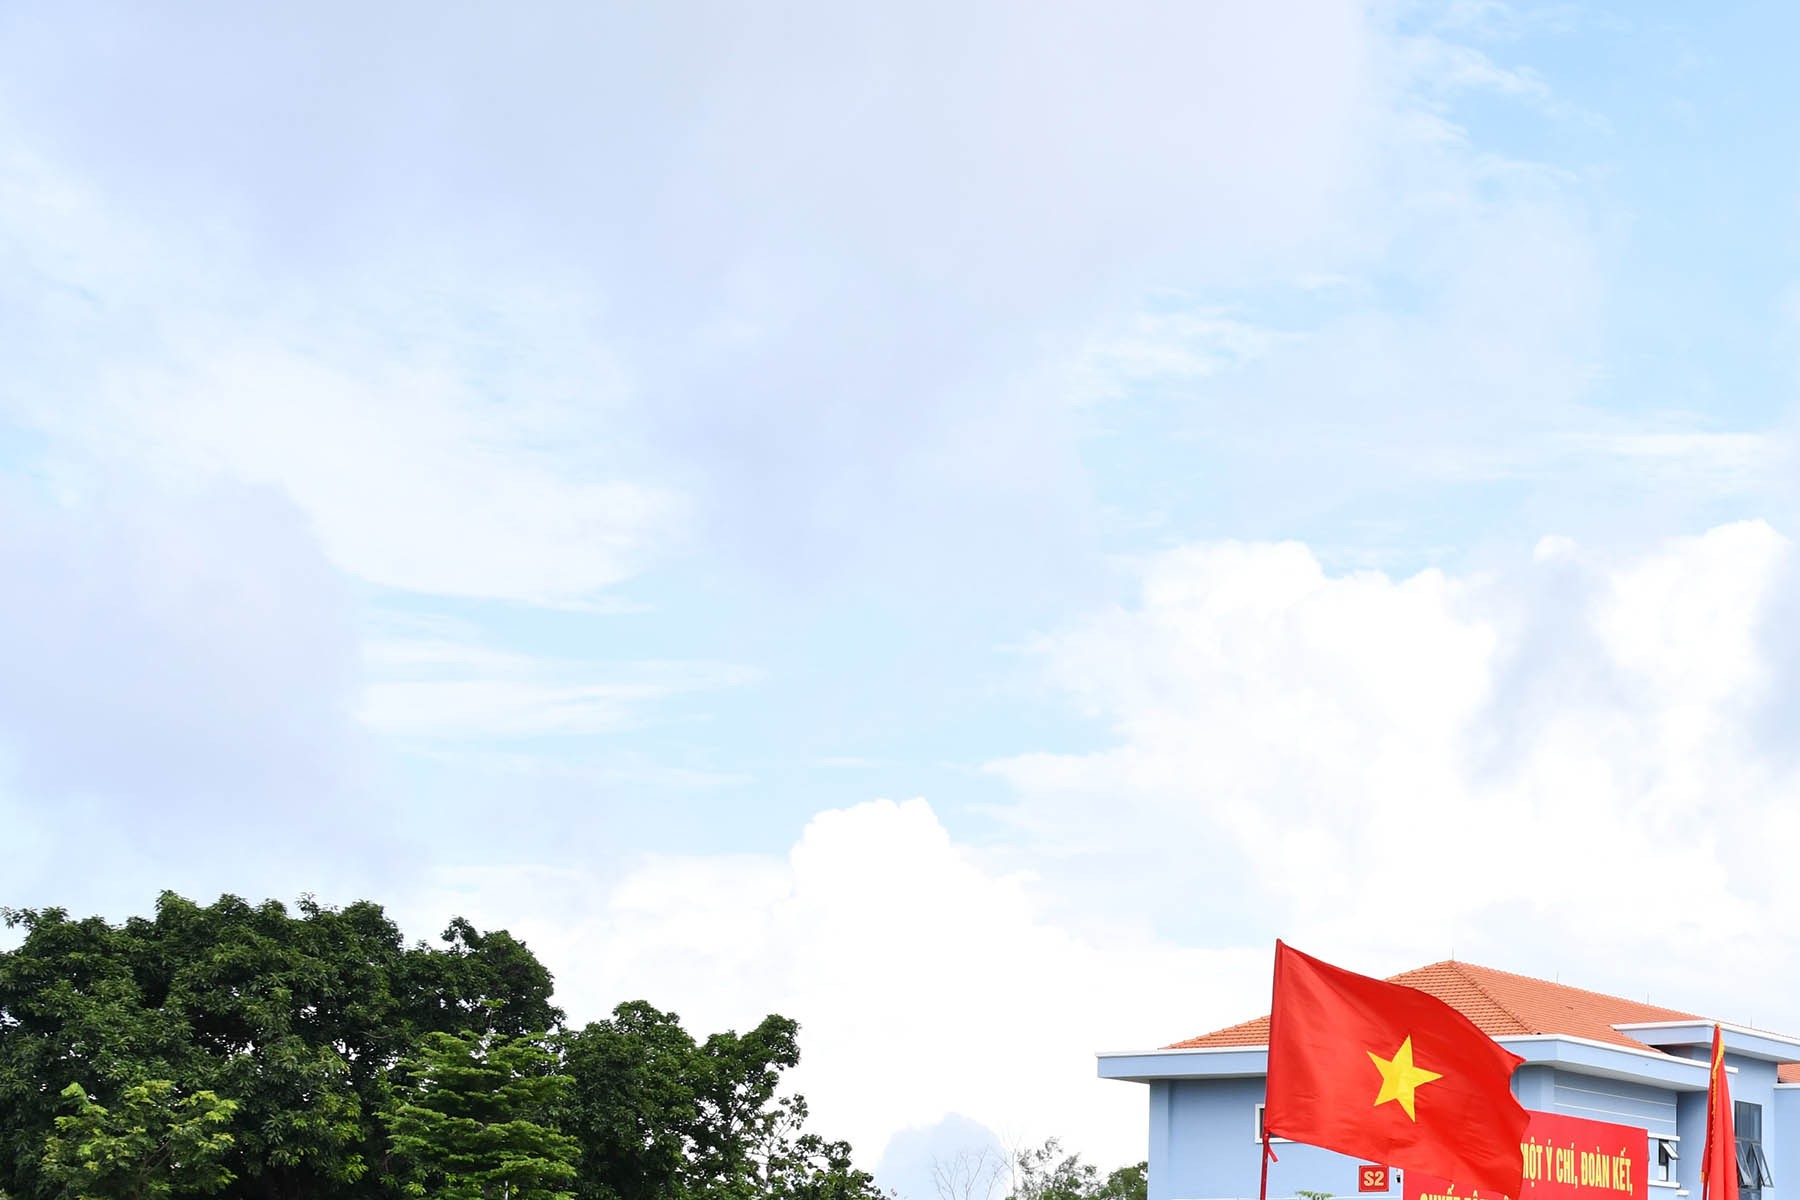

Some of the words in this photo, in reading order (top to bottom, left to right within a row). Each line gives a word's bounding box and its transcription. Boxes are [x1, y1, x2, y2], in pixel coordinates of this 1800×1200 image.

[1363, 1170, 1385, 1187] S2
[1545, 1138, 1553, 1181] Ý
[1556, 1142, 1578, 1189] CHÍ,
[1580, 1145, 1610, 1189] ĐOÀN
[1612, 1146, 1633, 1196] KẾT,
